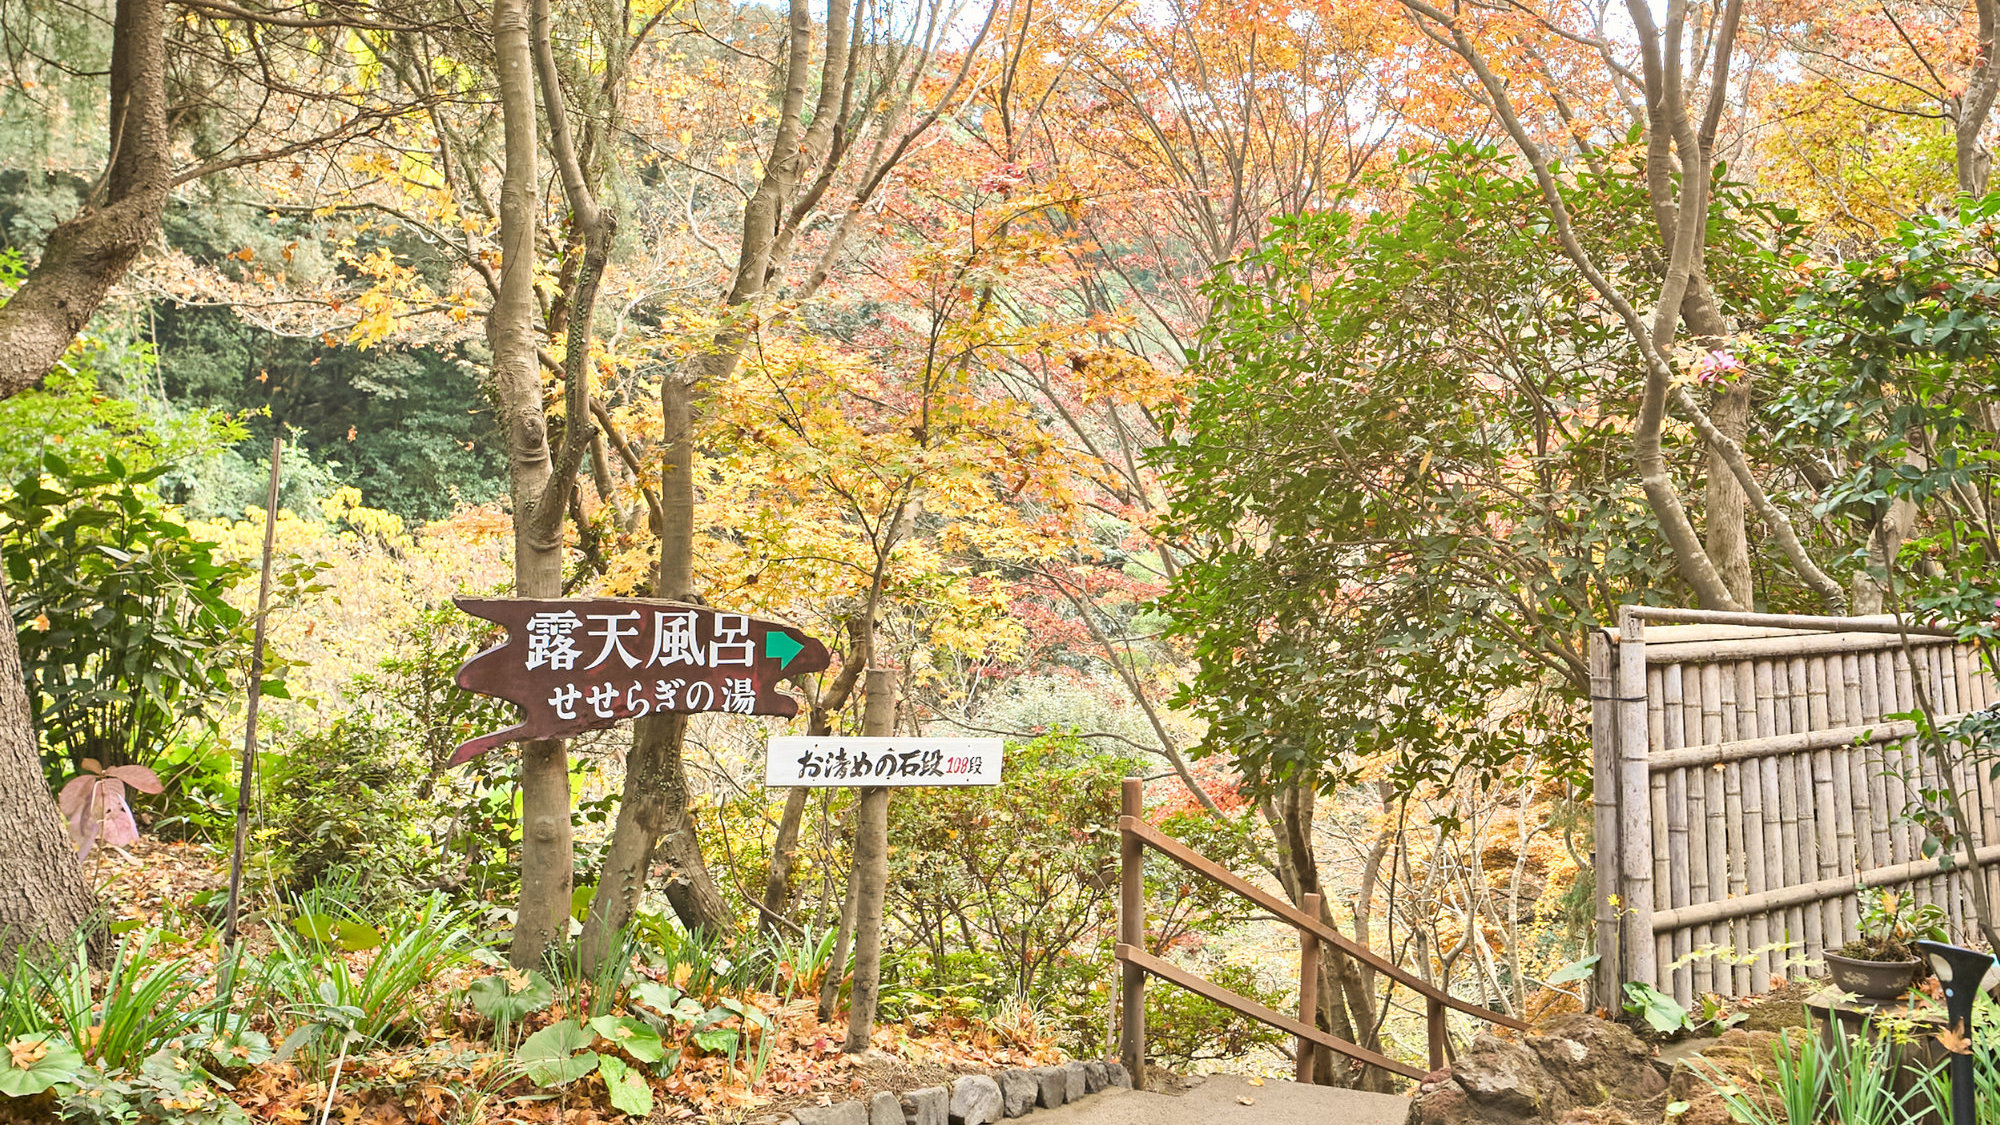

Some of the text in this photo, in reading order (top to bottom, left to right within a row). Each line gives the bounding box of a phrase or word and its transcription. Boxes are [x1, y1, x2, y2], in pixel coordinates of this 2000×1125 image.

[525, 609, 756, 672] 露天風呂
[547, 677, 757, 720] せせらぎの湯
